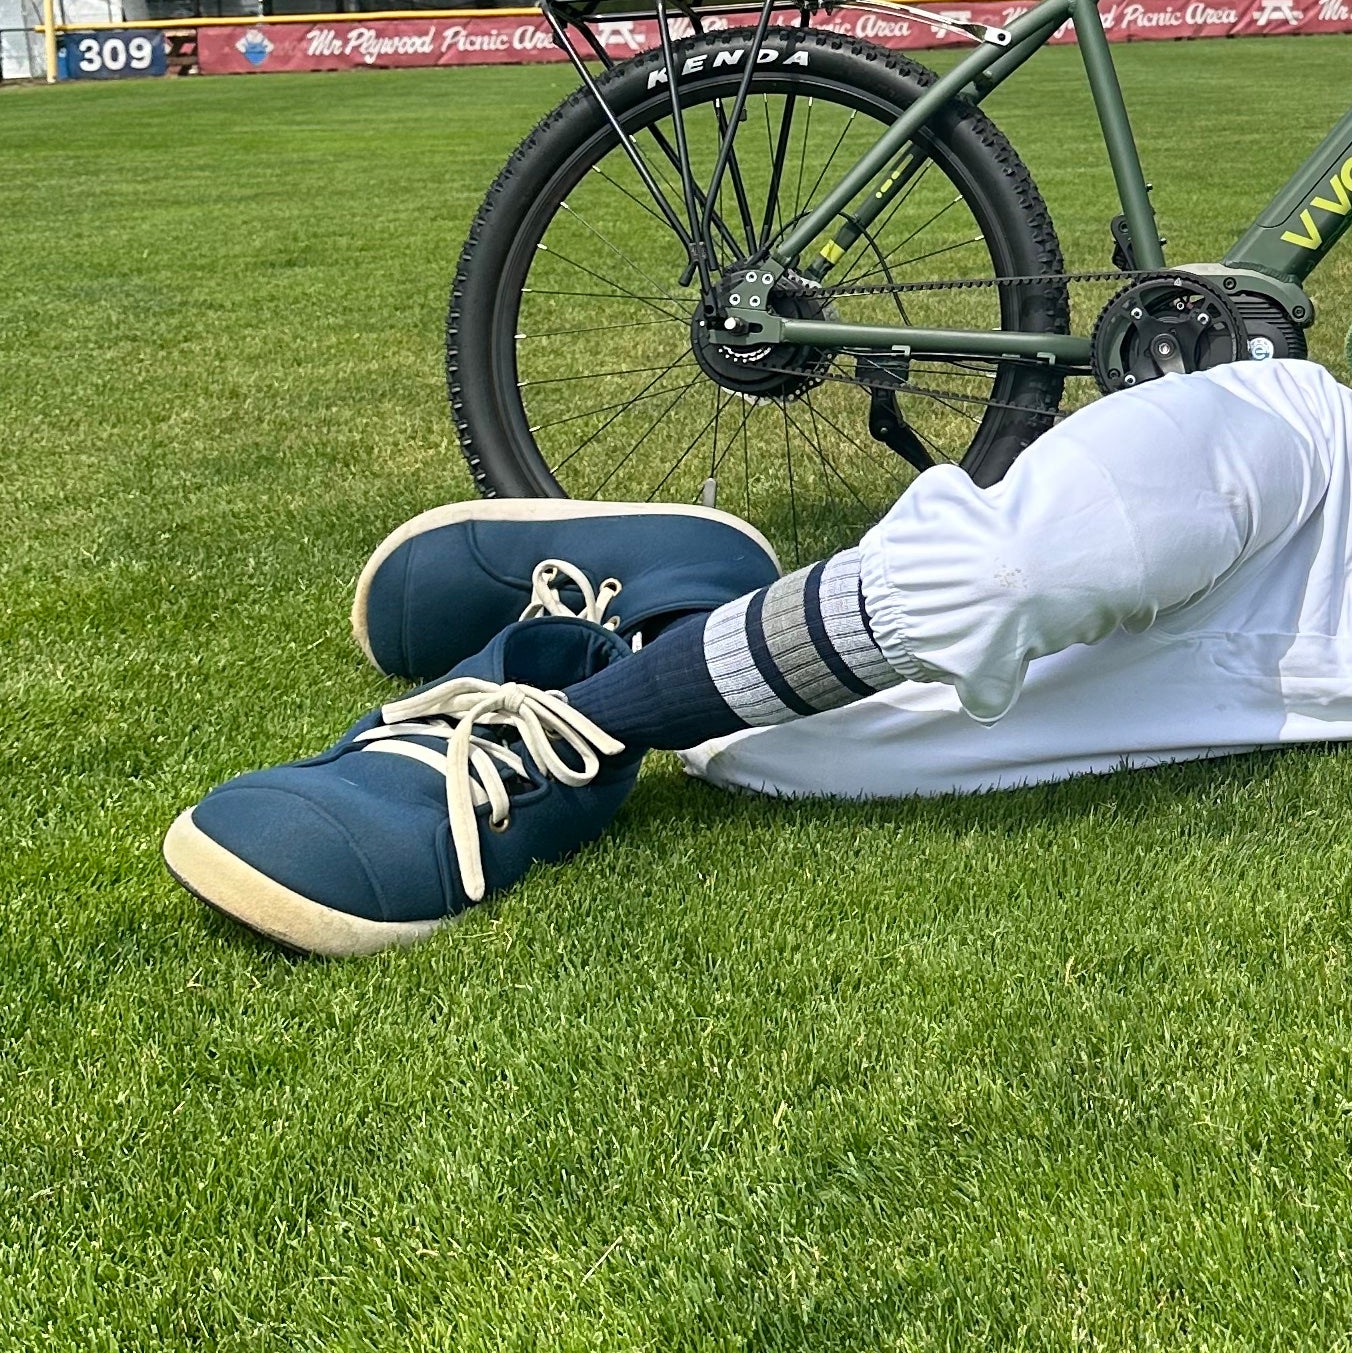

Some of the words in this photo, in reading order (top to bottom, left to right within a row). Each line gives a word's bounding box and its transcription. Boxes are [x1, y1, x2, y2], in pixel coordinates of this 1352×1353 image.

[855, 13, 911, 38] Area
[1121, 3, 1183, 29] Picnic
[1185, 1, 1238, 25] Area
[78, 36, 153, 73] 309
[345, 24, 435, 65] Plywood
[441, 25, 510, 53] Picnic
[645, 48, 811, 90] KENDA
[1280, 208, 1323, 250] V
